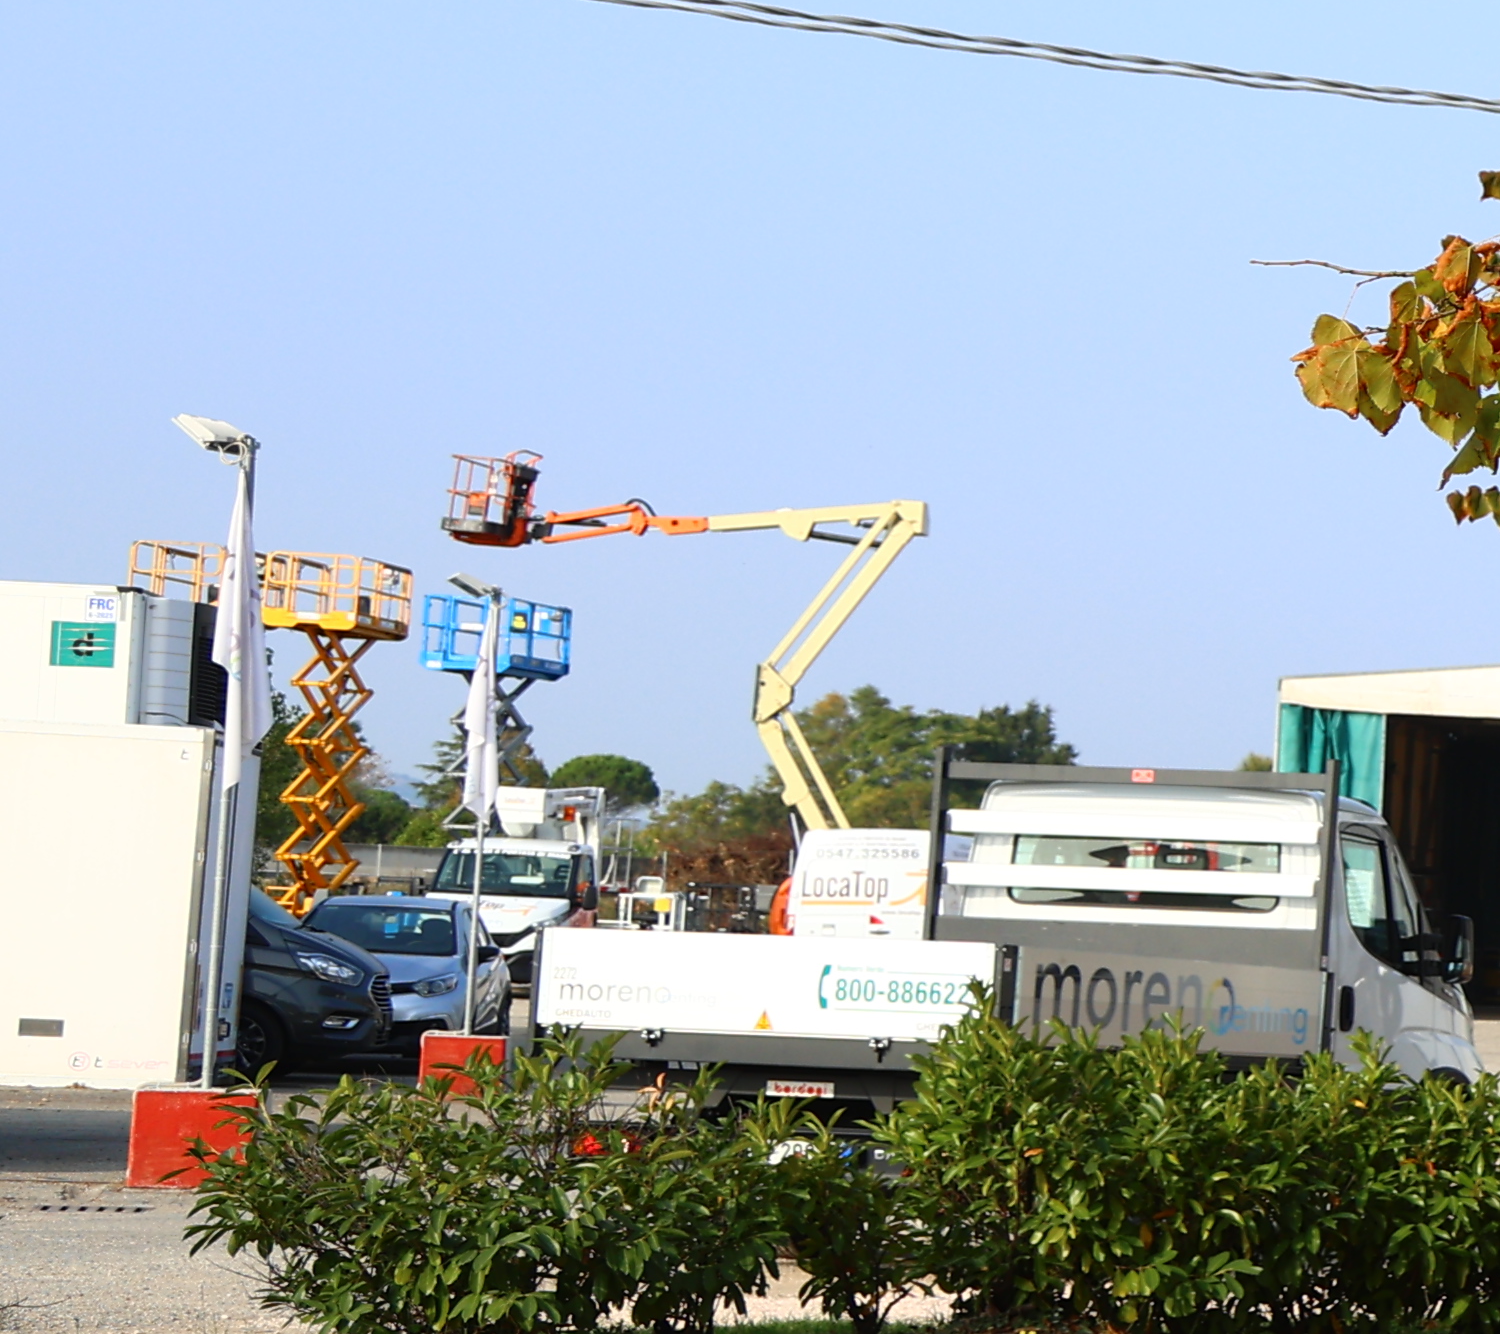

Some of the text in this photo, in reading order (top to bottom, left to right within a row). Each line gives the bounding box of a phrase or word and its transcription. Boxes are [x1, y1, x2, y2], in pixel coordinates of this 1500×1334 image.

[89, 598, 115, 611] FRC
[816, 848, 920, 859] 0547.325586
[802, 871, 888, 903] LocaTop
[560, 983, 671, 1004] moreno
[1032, 962, 1236, 1035] moreno
